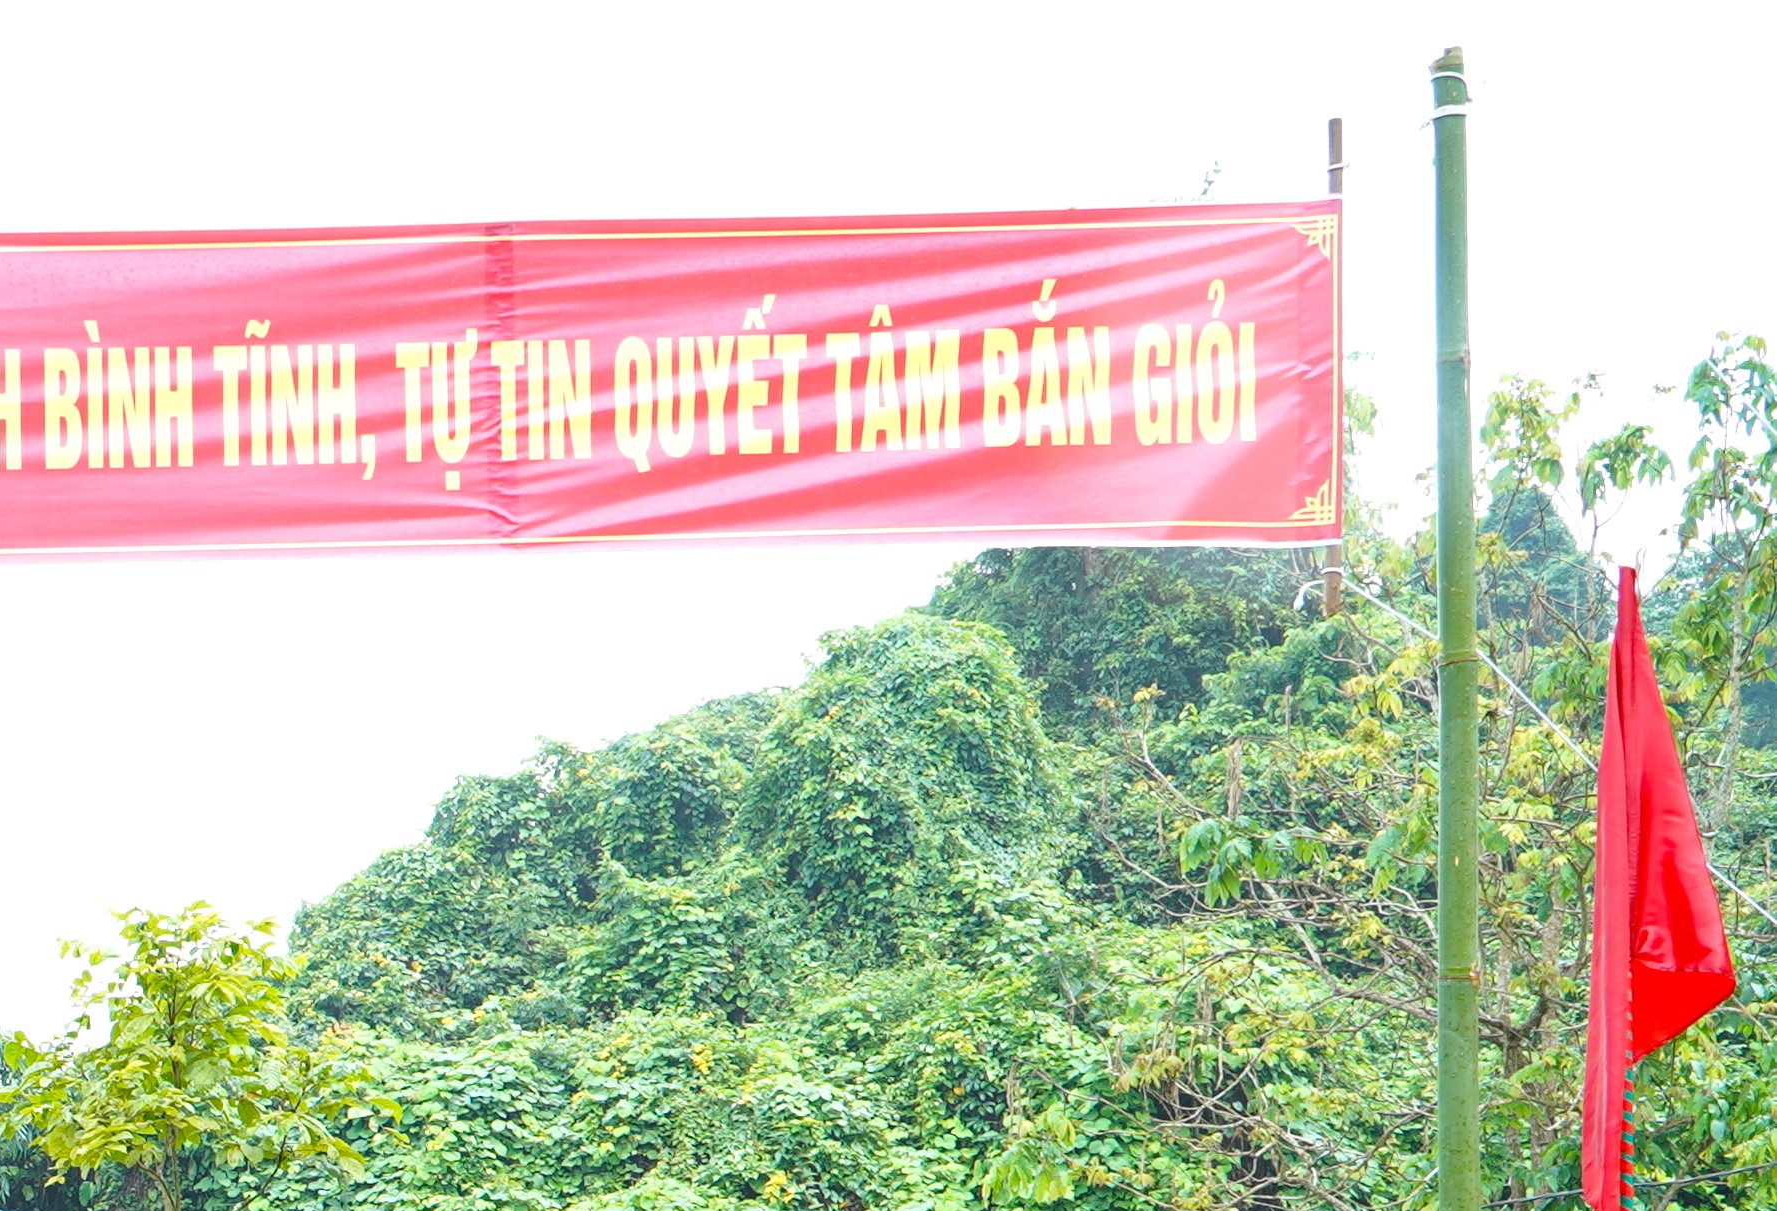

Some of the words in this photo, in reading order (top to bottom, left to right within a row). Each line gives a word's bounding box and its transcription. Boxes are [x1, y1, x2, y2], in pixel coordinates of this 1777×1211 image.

[44, 320, 194, 468] BÌNH
[213, 319, 376, 480] TĨNH,
[395, 328, 478, 491] TỰ
[491, 339, 592, 461] TIN
[614, 294, 808, 473] QUYẾT
[825, 304, 961, 454] TÂM
[981, 279, 1112, 448] BẮN
[1133, 278, 1258, 445] GIỎI
